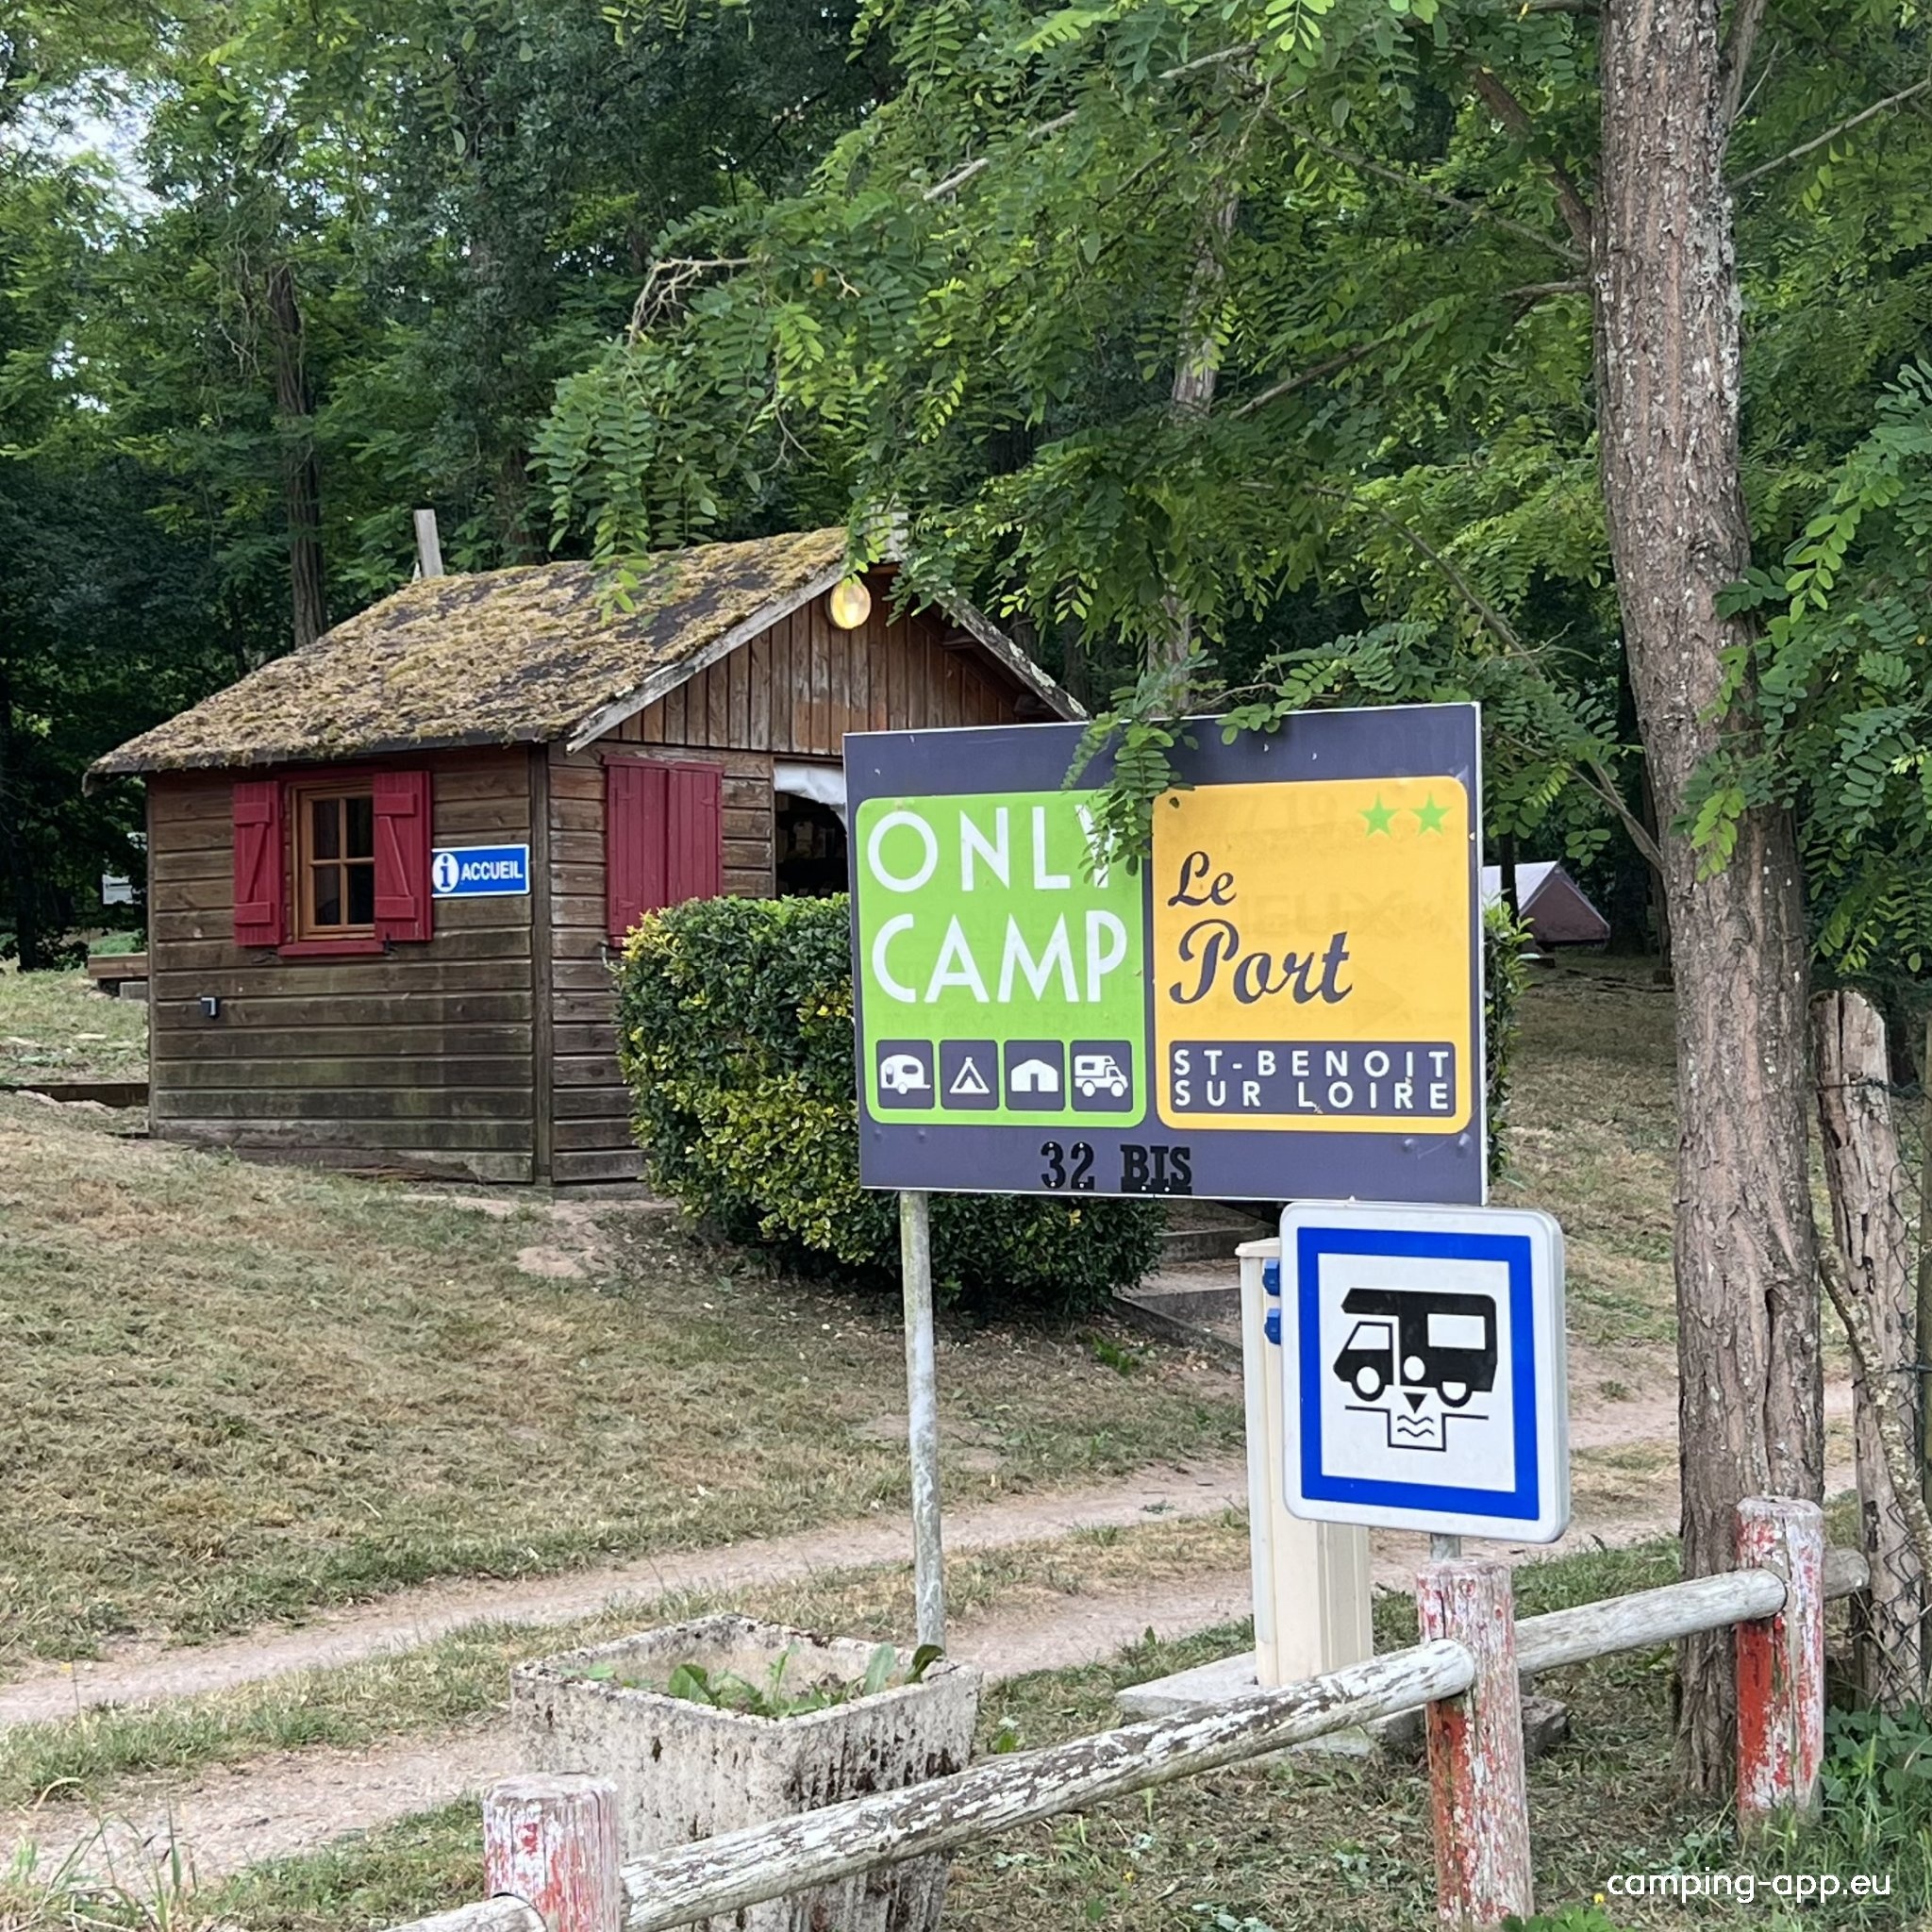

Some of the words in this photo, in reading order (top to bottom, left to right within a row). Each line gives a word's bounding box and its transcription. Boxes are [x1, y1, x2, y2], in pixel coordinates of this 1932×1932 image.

[460, 860, 524, 881] ACCUEIL
[1168, 851, 1237, 907] Le
[871, 910, 1127, 1005] CAMP
[1169, 918, 1353, 1004] Port
[1174, 1049, 1449, 1078] ST-BENOIT
[1174, 1080, 1261, 1107] SUR
[1298, 1081, 1449, 1109] LOIRE
[1041, 1141, 1094, 1190] 32
[1120, 1144, 1191, 1195] BIS
